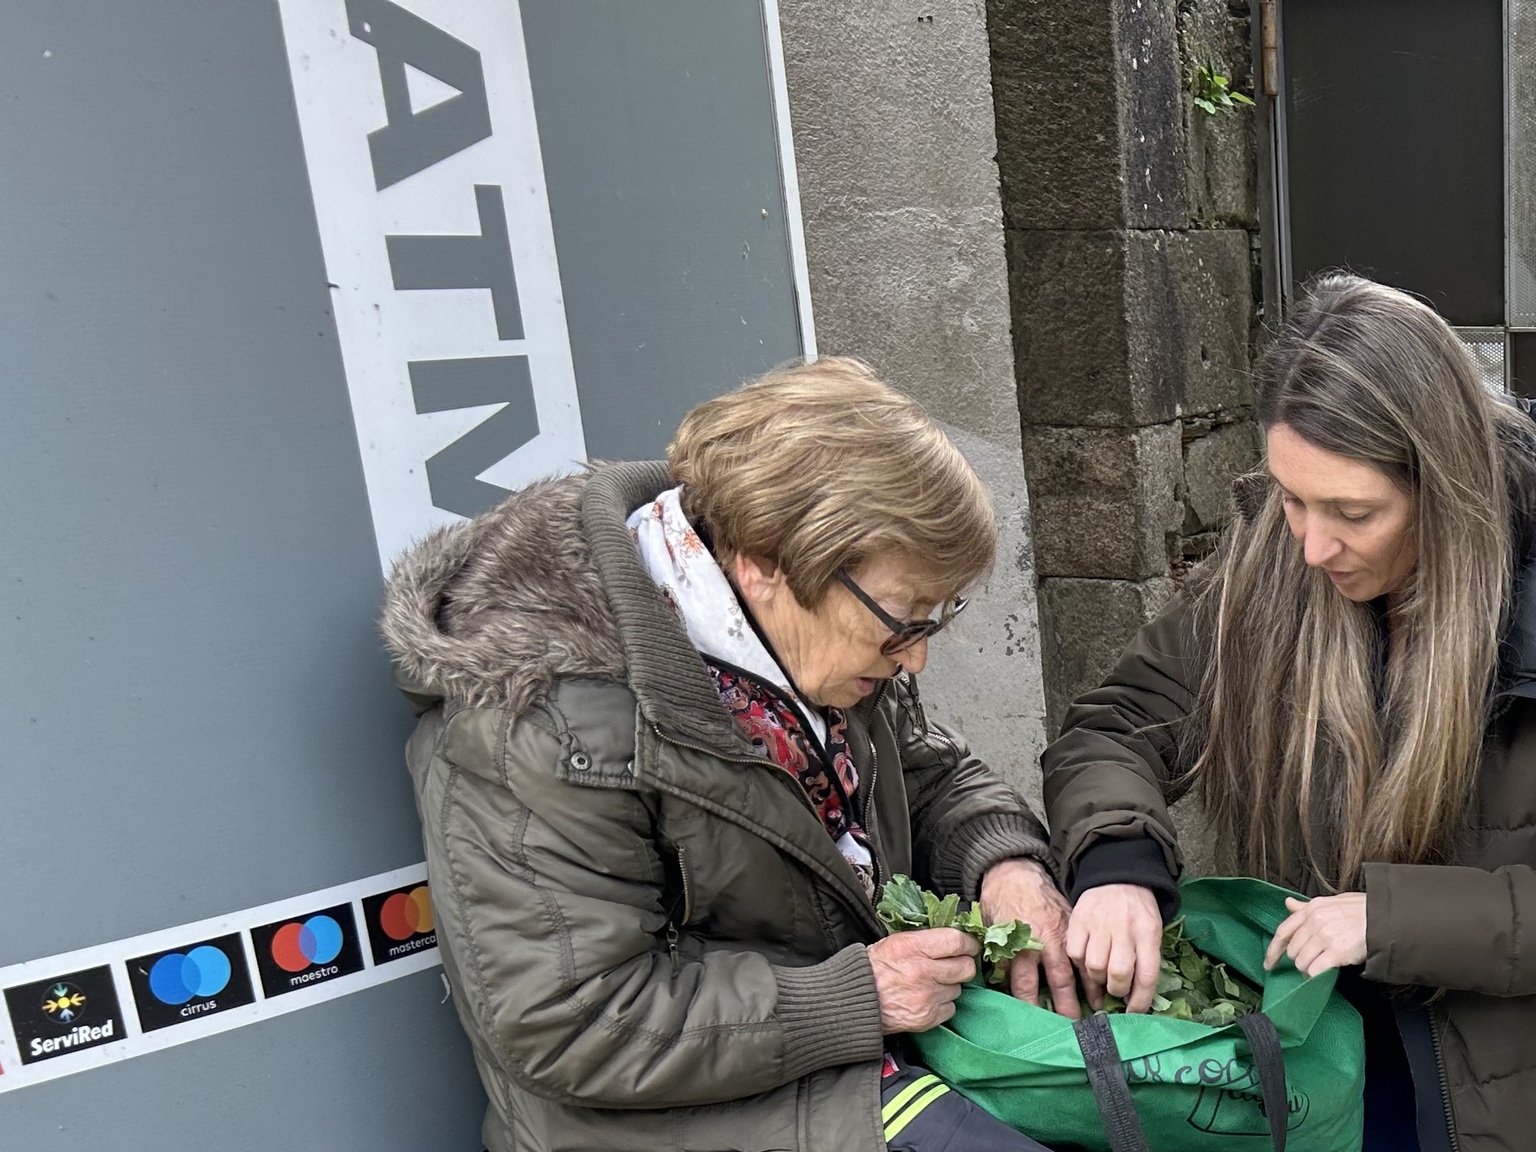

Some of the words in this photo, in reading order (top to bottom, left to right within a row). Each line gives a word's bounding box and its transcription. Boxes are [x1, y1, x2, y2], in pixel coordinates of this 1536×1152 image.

[346, 0, 540, 519] ATM
[389, 934, 437, 957] masterca
[290, 964, 339, 987] maestro
[180, 999, 217, 1018] cirrus
[30, 1019, 114, 1057] ServiRed
